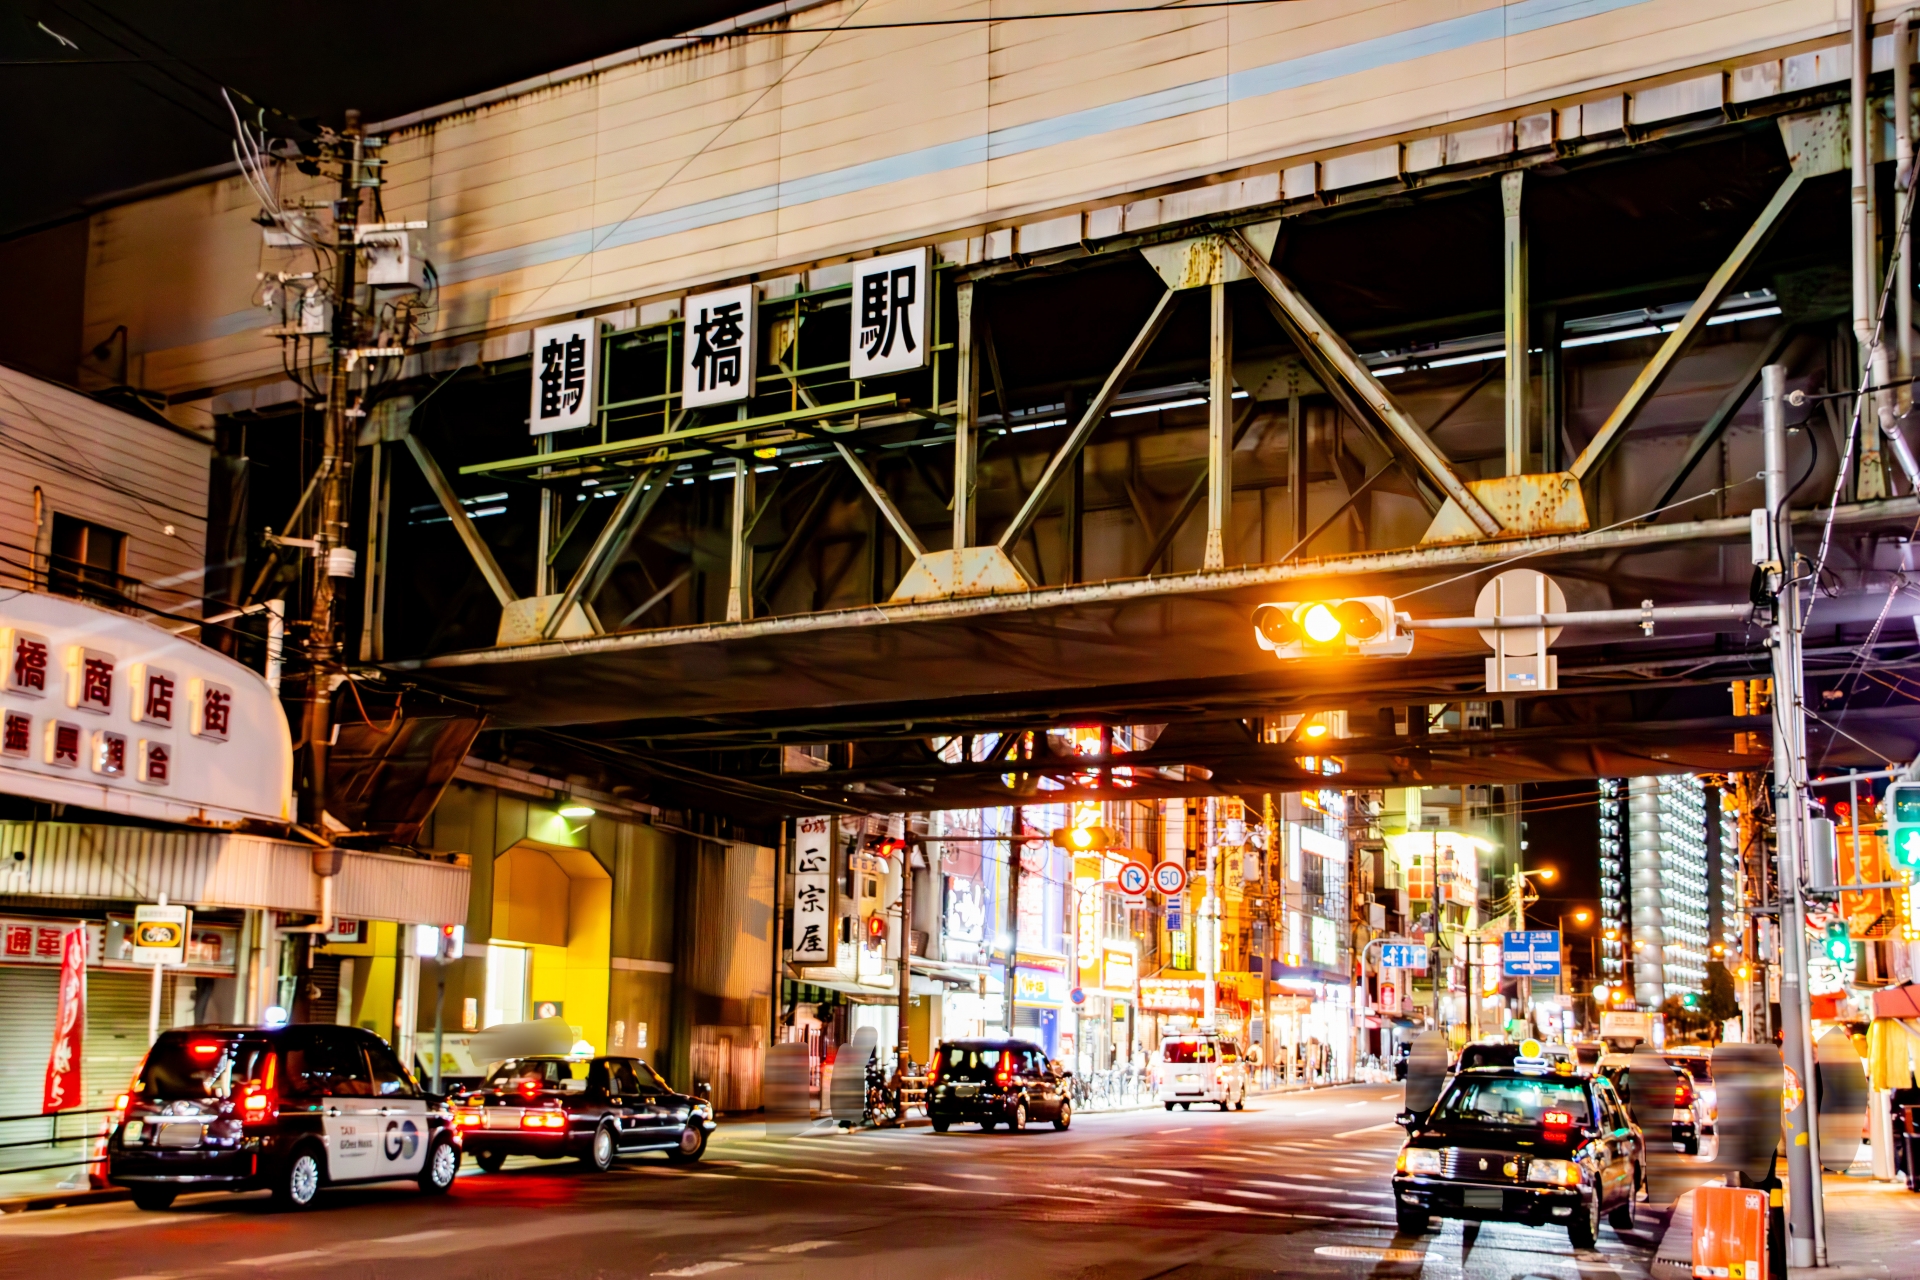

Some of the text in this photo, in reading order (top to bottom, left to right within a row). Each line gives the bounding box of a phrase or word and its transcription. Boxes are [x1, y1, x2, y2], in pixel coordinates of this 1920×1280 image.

[539, 265, 917, 420] 鶴橋駅
[14, 638, 232, 735] 橋商店街
[1160, 870, 1179, 886] 50
[796, 848, 827, 952] 正宗屋
[1167, 893, 1181, 929] 二輪
[340, 1126, 356, 1135] TAXI
[384, 1120, 419, 1161] GO
